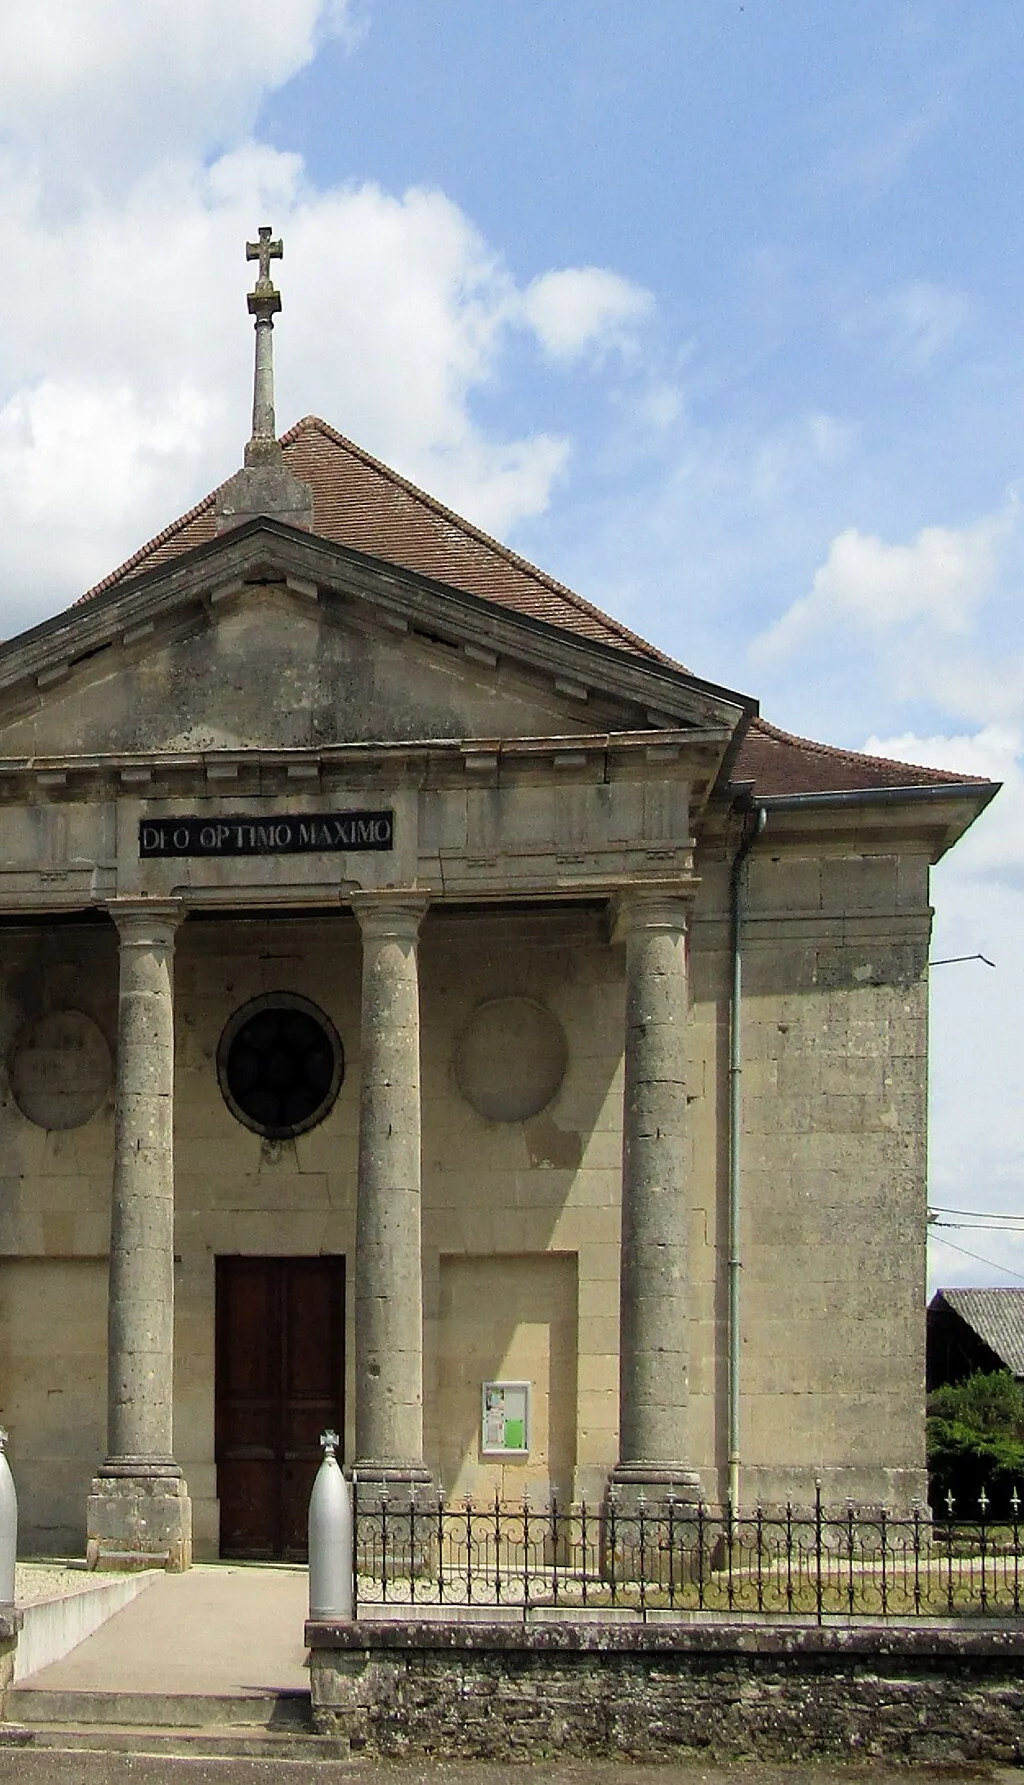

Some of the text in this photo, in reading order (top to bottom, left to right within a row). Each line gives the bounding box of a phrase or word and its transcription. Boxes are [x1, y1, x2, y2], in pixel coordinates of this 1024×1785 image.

[142, 819, 391, 851] DEO OPTIMO MAXIMO
